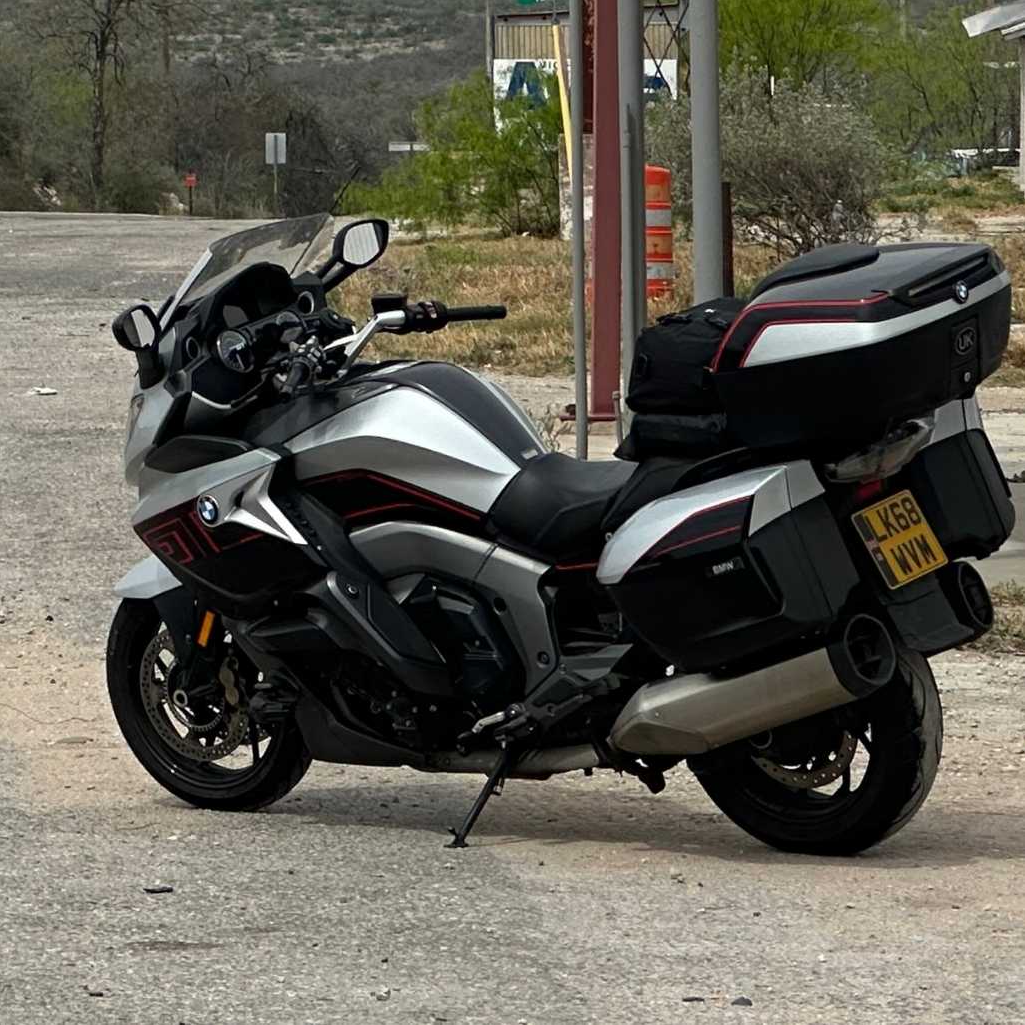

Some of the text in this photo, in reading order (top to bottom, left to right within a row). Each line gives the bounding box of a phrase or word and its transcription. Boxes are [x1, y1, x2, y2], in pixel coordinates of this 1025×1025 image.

[958, 331, 974, 350] UK
[863, 496, 922, 543] LK68
[889, 533, 938, 576] WVM
